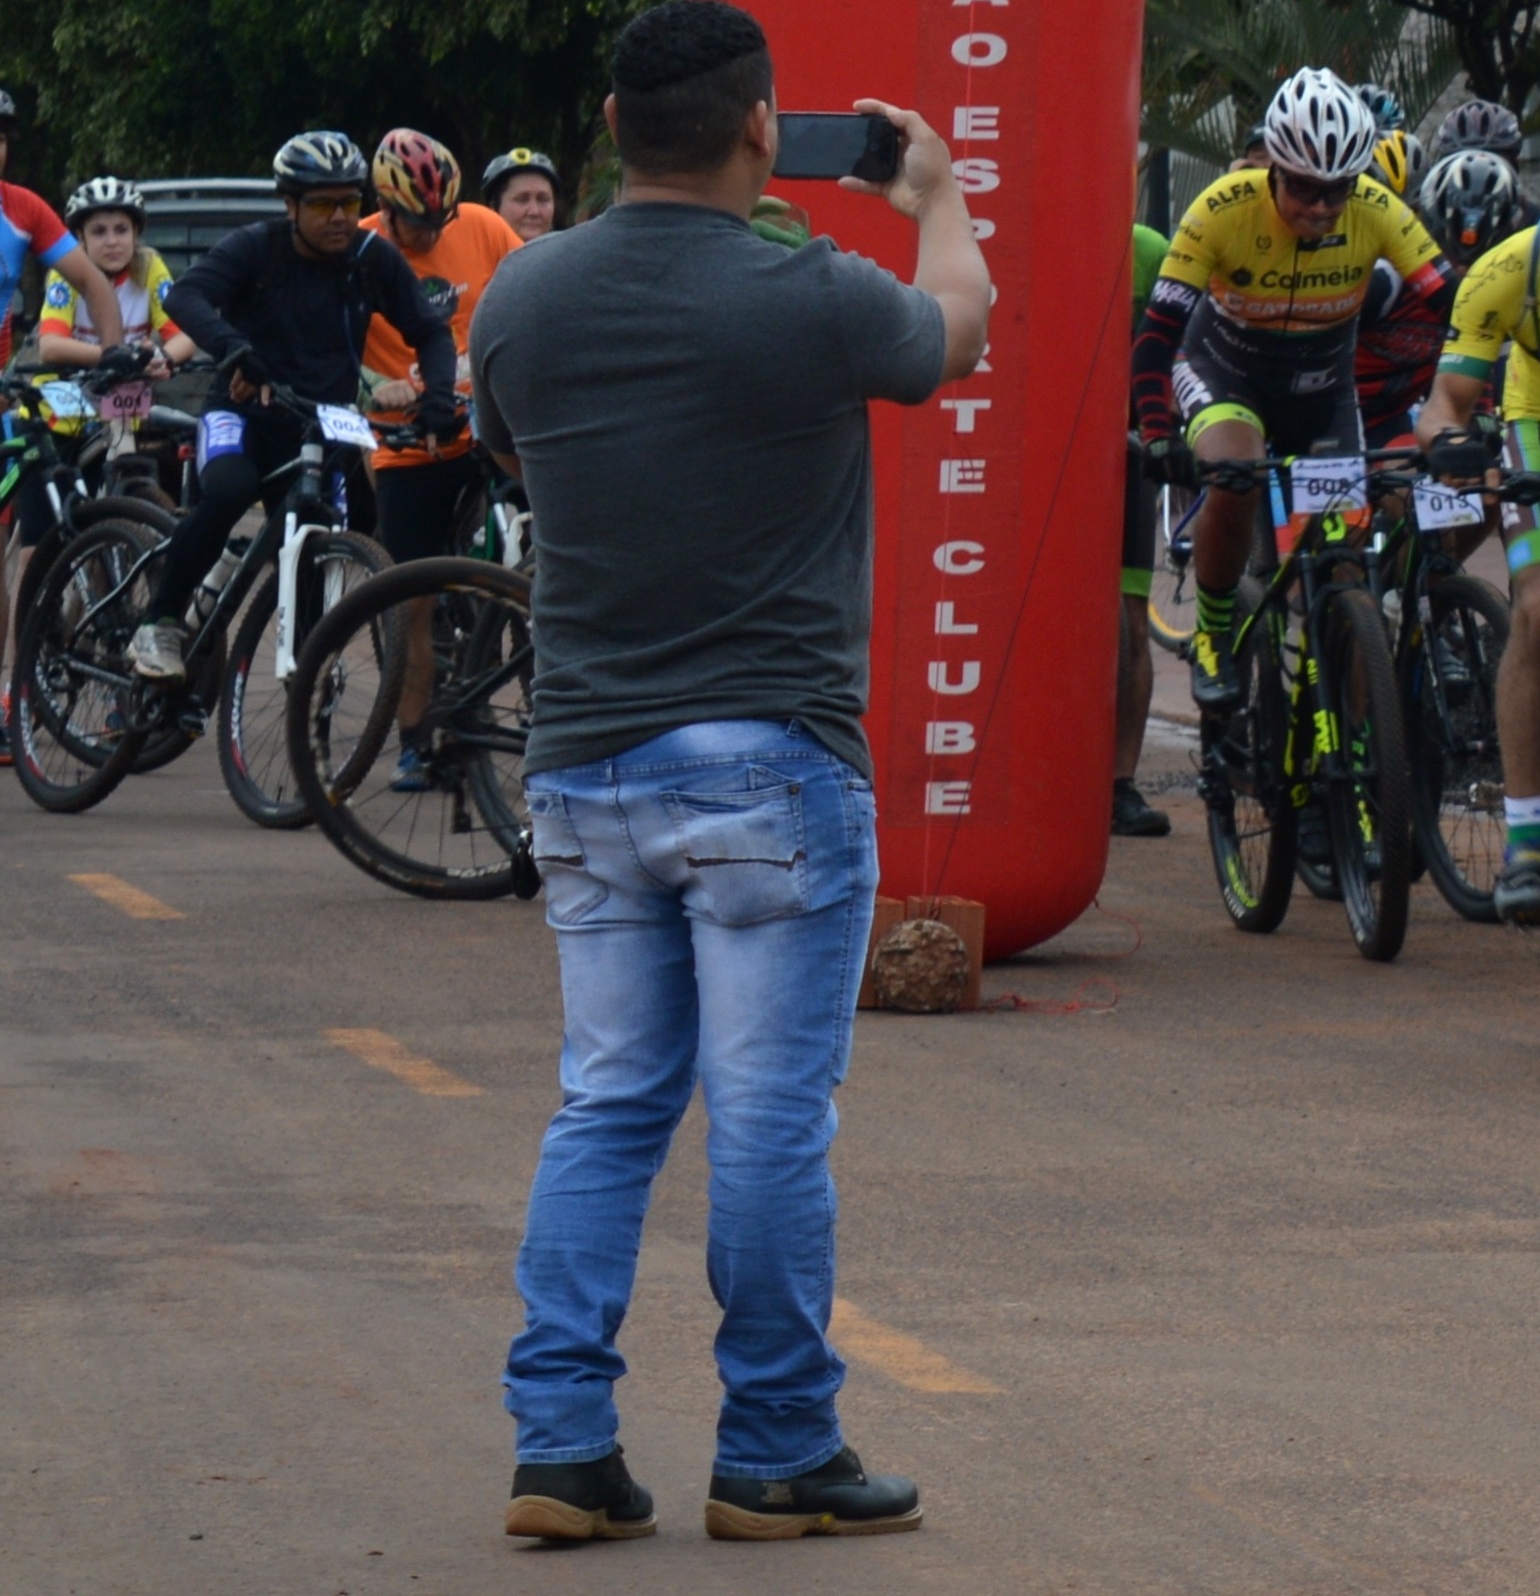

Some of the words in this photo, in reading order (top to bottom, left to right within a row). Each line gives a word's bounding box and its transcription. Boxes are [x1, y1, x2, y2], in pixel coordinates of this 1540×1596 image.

[1205, 180, 1257, 212] ALFA
[1352, 184, 1390, 210] LFA
[1260, 265, 1364, 290] Colmeia
[1429, 493, 1470, 512] 013
[924, 539, 985, 815] CLUBE
